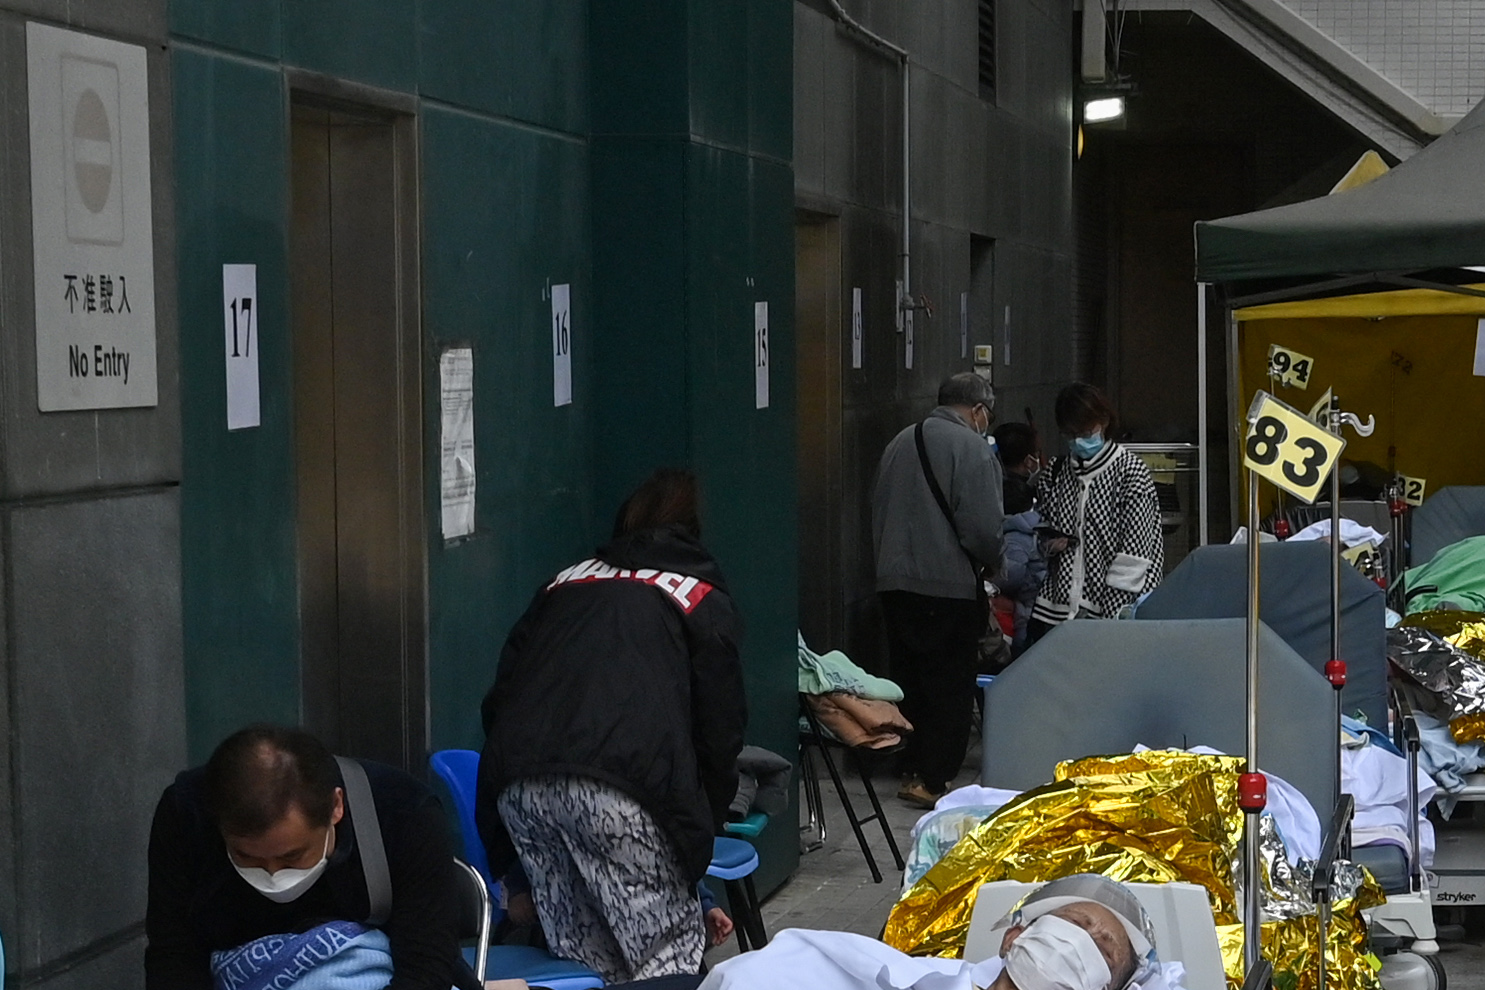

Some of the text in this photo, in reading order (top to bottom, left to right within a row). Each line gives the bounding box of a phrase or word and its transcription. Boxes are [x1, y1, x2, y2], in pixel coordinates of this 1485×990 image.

[64, 274, 131, 314] 不准駛入
[230, 297, 252, 357] 17
[555, 310, 568, 356] 16
[69, 344, 130, 385] No Entry
[757, 328, 766, 367] 15
[1273, 352, 1310, 383] 94
[1246, 416, 1328, 488] 83
[1436, 891, 1476, 903] stryker
